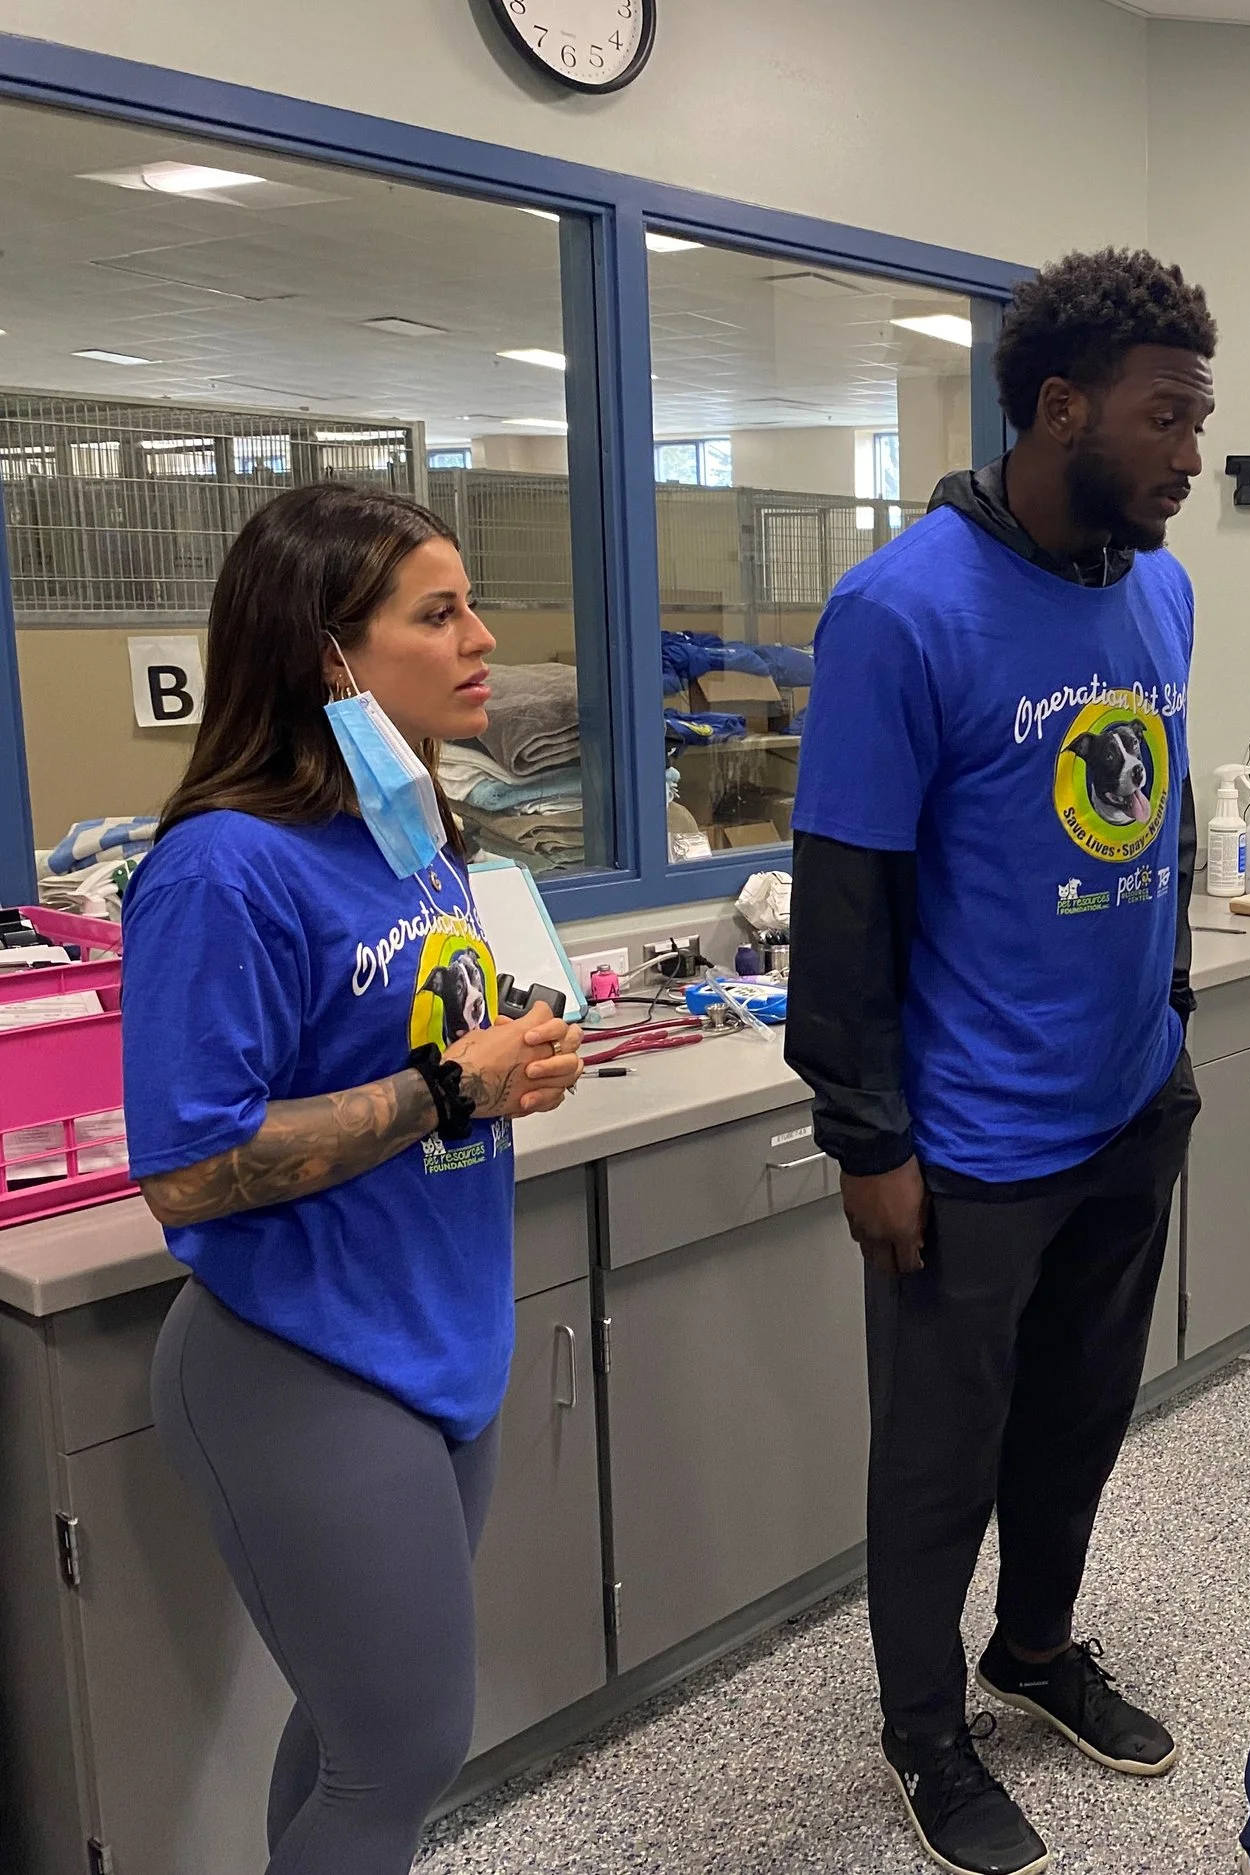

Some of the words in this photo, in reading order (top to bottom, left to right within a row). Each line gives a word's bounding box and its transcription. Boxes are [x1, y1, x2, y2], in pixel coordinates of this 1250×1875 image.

[533, 25, 549, 48] 7
[608, 30, 623, 51] 4
[561, 44, 577, 68] 6
[589, 44, 604, 68] 5
[147, 664, 194, 721] B
[1013, 673, 1129, 744] Operation
[1133, 680, 1159, 716] Pit
[1064, 806, 1086, 840] Save
[1085, 834, 1115, 857] Lives
[1122, 837, 1145, 857] Spay
[1116, 867, 1142, 907] pet
[1056, 900, 1071, 915] pet
[1072, 894, 1110, 906] resources
[352, 900, 459, 997] Operation
[423, 1155, 439, 1176] pet
[440, 1144, 485, 1164] resources
